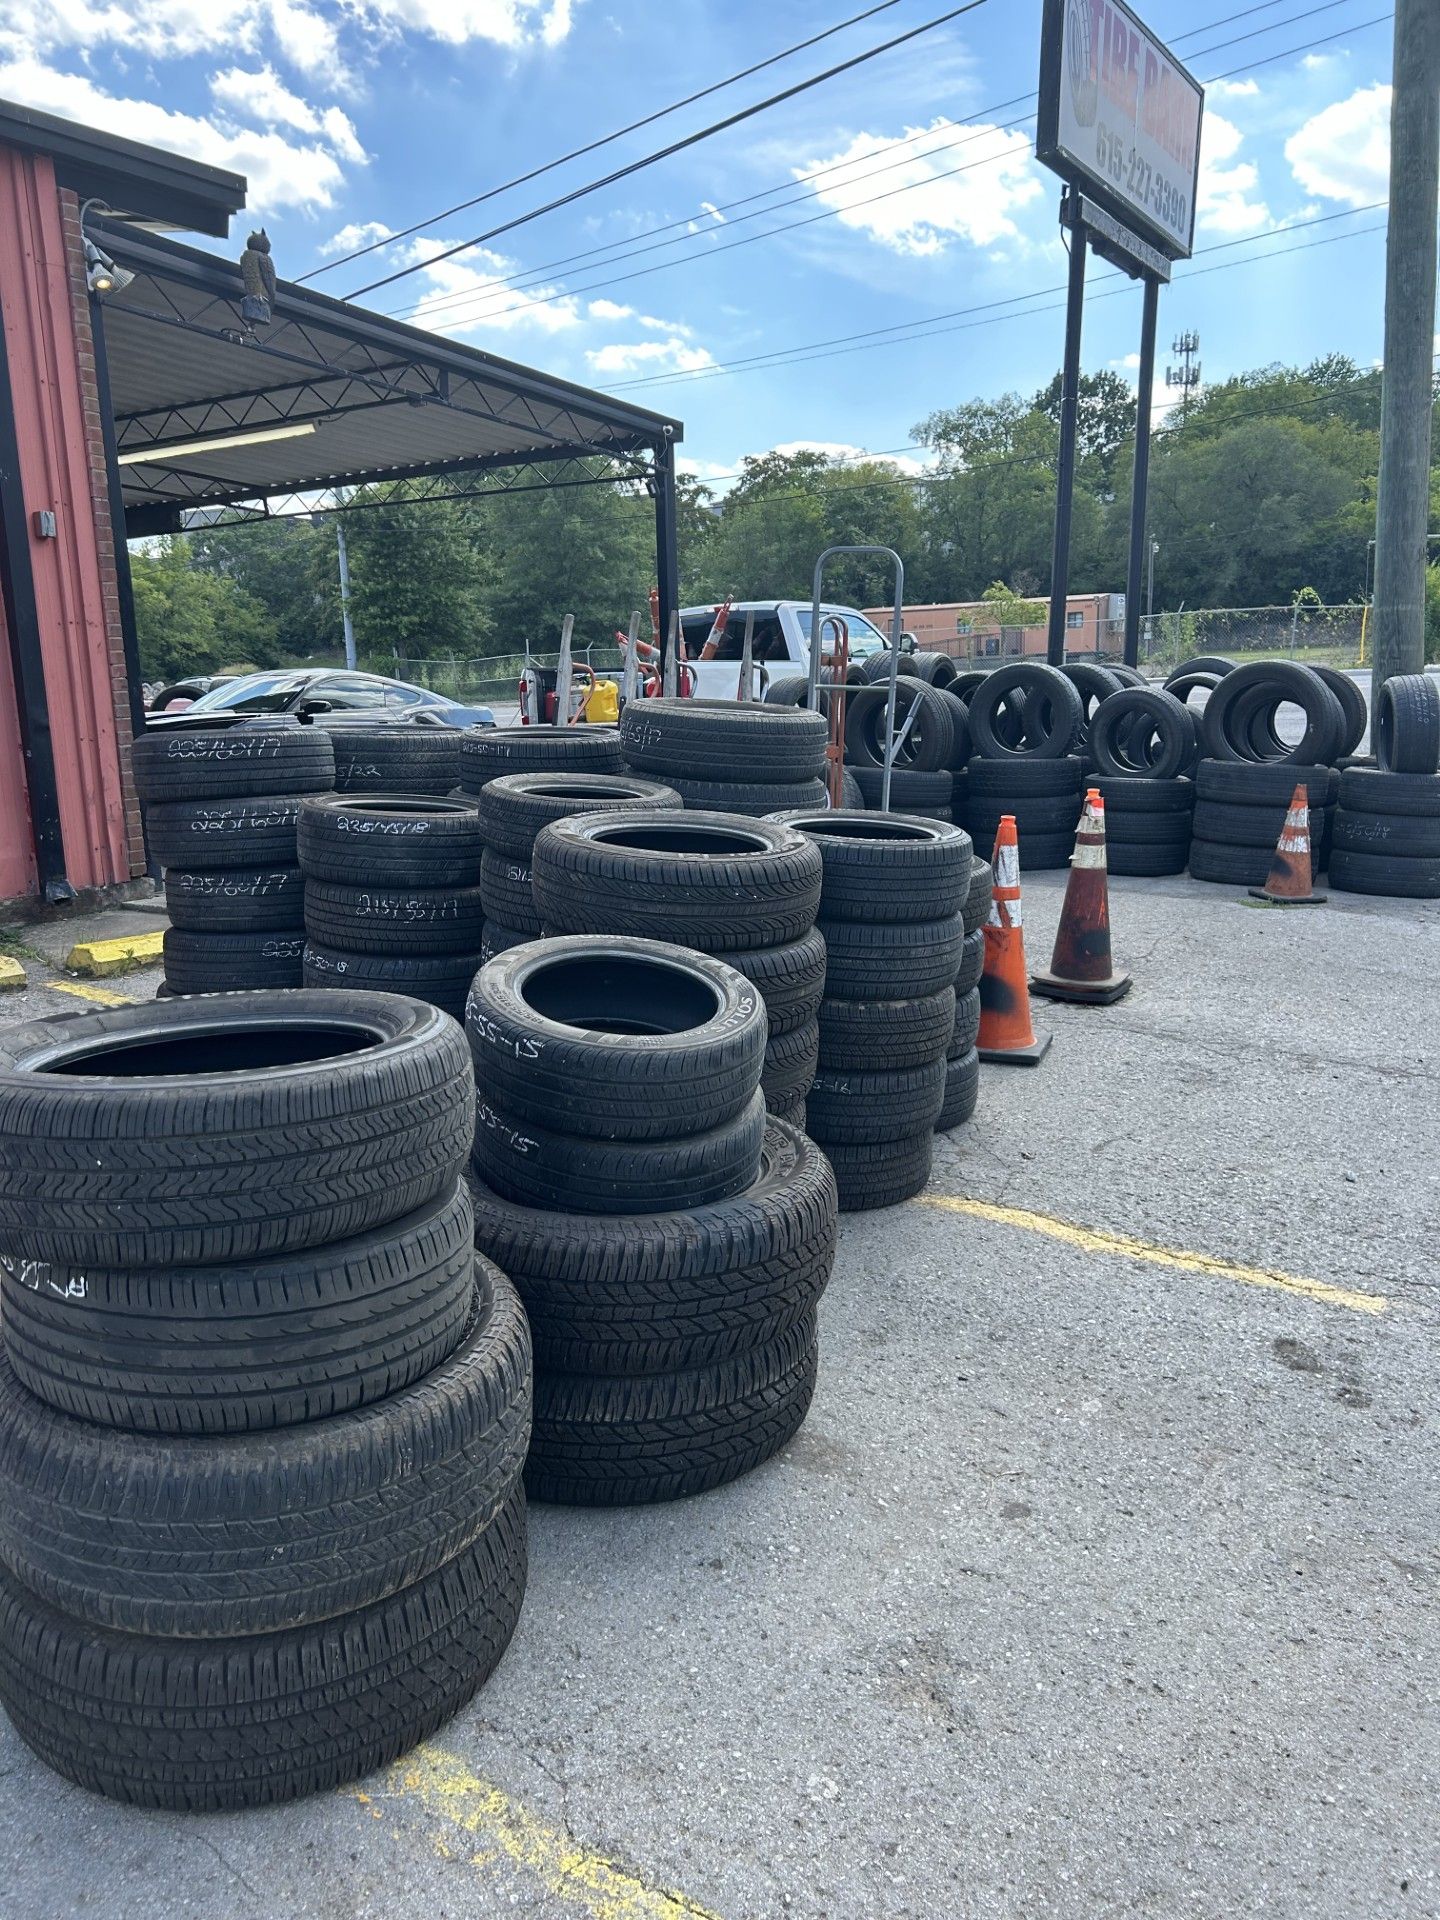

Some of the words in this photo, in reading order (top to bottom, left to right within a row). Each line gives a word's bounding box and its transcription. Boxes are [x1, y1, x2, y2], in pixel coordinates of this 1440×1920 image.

[1087, 0, 1141, 121] TIRE
[1096, 121, 1187, 235] 615-227-3390
[710, 996, 753, 1033] SOLUS
